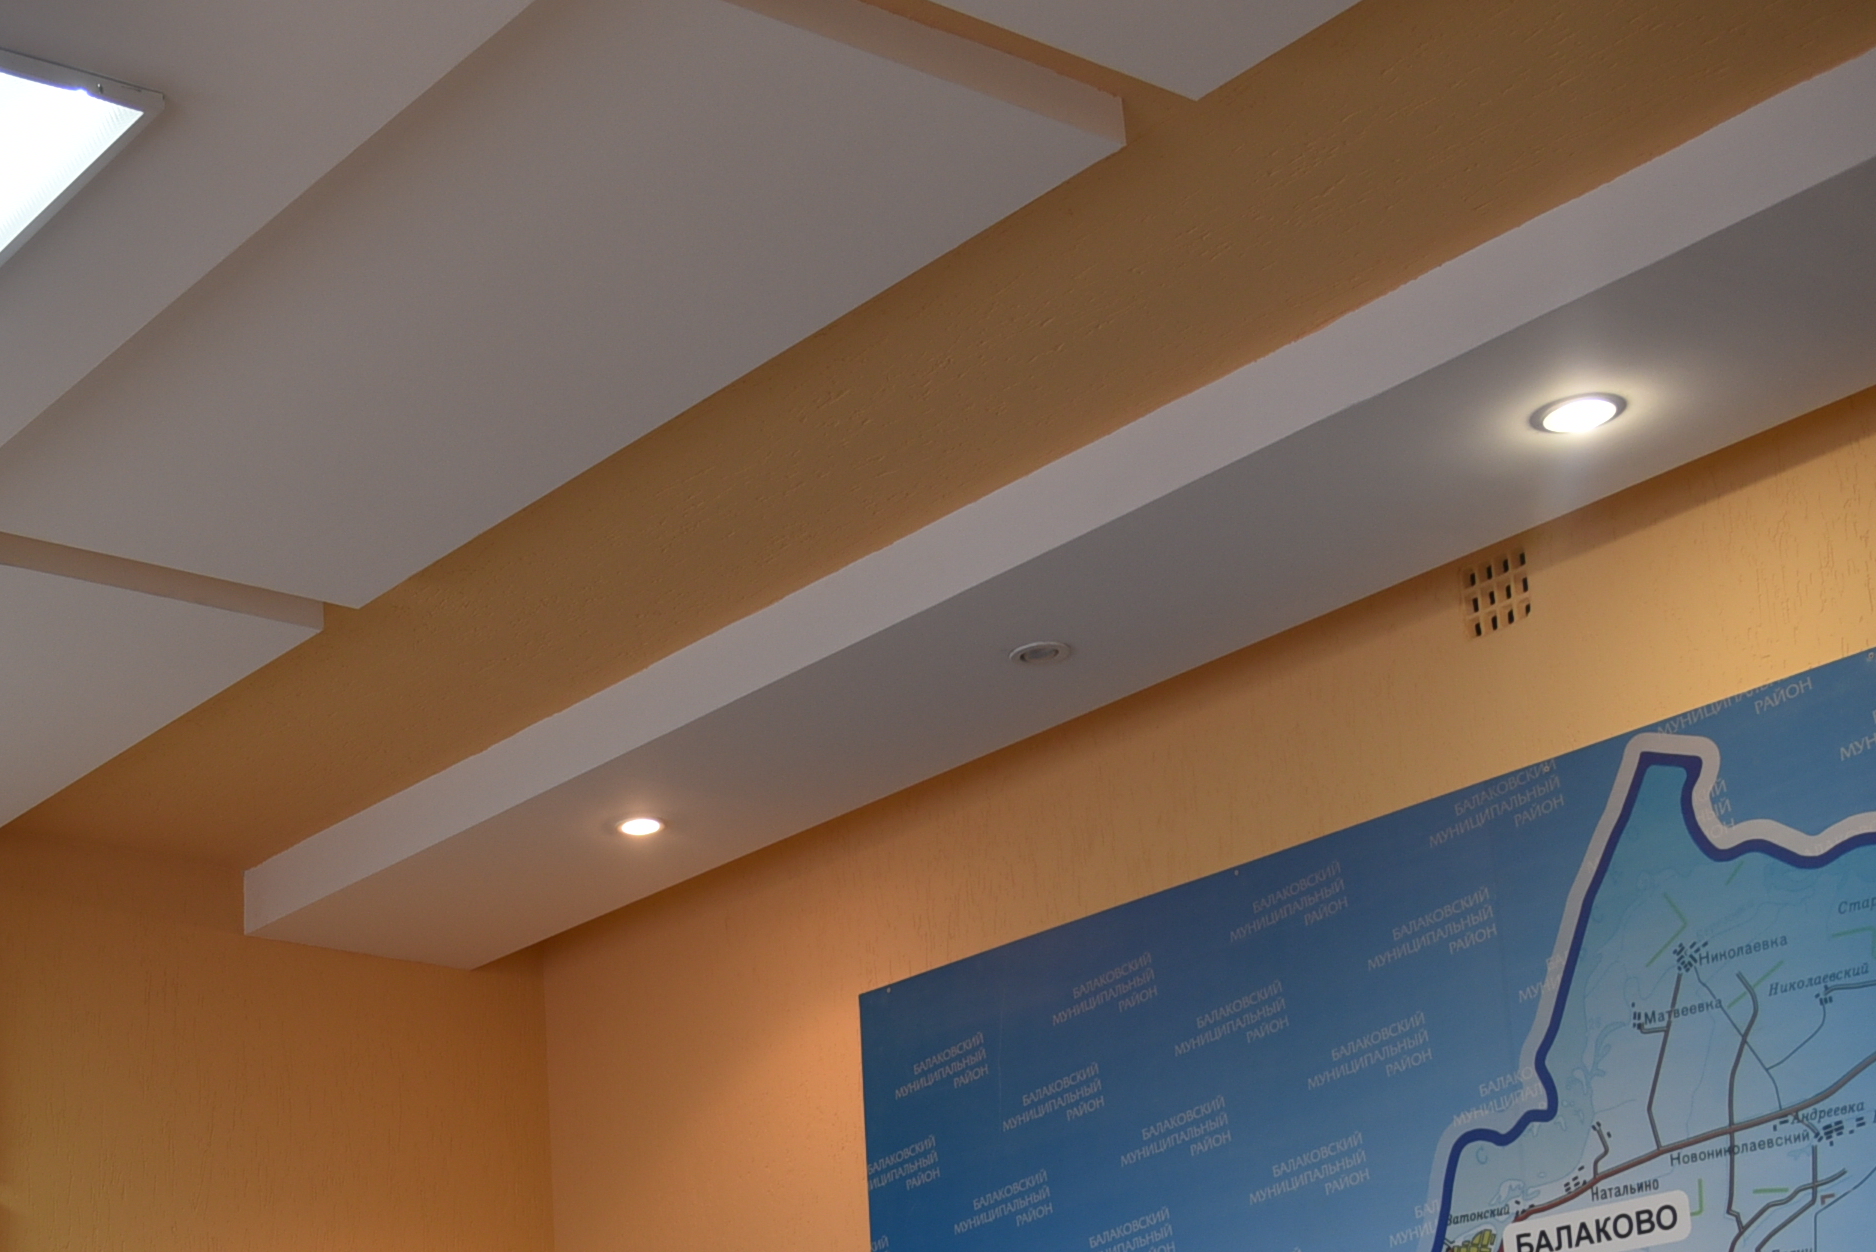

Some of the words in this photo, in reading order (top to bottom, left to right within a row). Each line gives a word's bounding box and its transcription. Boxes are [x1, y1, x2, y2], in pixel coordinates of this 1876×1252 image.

[1753, 676, 1814, 716] РАЙОН
[1429, 774, 1561, 848] МУНИЦИПАЛЬНЫЙ
[1514, 794, 1564, 828] РАЙОН
[1392, 886, 1490, 941] БАЛАКОВСКИЙ
[1368, 904, 1494, 972] МУНИЦИПАЛЬНЫЙ
[1448, 923, 1497, 955] РАЙОН
[1698, 934, 1789, 966] Николаевка
[1052, 967, 1155, 1026] МУНИЦИПАЛЬНЫЙ
[1073, 952, 1152, 999] БАЛАКОВСКИЙ
[1768, 962, 1870, 997] Николаевский
[1118, 985, 1158, 1013] РАЙОН
[1196, 979, 1283, 1029] БАЛАКОВСКИЙ
[1643, 997, 1723, 1026] Матвеевка
[1174, 997, 1286, 1057] МУНИЦИПАЛЬНЫЙ
[1246, 1015, 1289, 1043] РАЙОН
[1331, 1011, 1425, 1061] БАЛАКОВСКИЙ
[894, 1047, 987, 1100] МУНИЦИПАЛЬНЫЙ
[913, 1031, 984, 1075] БАЛАКОВСКИЙ
[1307, 1029, 1429, 1090] МУНИЦИПАЛЬНЫЙ
[1386, 1048, 1432, 1077] РАЙОН
[953, 1064, 989, 1089] РАЙОН
[1022, 1061, 1099, 1106] БАЛАКОВСКИЙ
[1002, 1078, 1102, 1132] МУНИЦИПАЛЬНЫЙ
[1066, 1095, 1105, 1121] РАЙОН
[1141, 1095, 1225, 1141] БАЛАКОВСКИЙ
[1790, 1100, 1865, 1125] Андреевка
[1120, 1111, 1229, 1167] МУНИЦИПАЛЬНЫЙ
[1190, 1130, 1232, 1157] РАЙОН
[1272, 1130, 1363, 1178] БАЛАКОВСКИЙ
[1670, 1130, 1810, 1167] Новониколаевский
[905, 1166, 941, 1192] РАЙОН
[973, 1168, 1048, 1211] БАЛАКОВСКИЙ
[1248, 1149, 1367, 1206] МУНИЦИПАЛЬНЫЙ
[1324, 1167, 1370, 1196] РАЙОН
[1591, 1178, 1660, 1202] Натальино
[954, 1185, 1051, 1236] МУНИЦИПАЛЬНЫЙ
[1016, 1202, 1053, 1227] РАЙОН
[1089, 1206, 1170, 1249] БАЛАКОВСКИЙ
